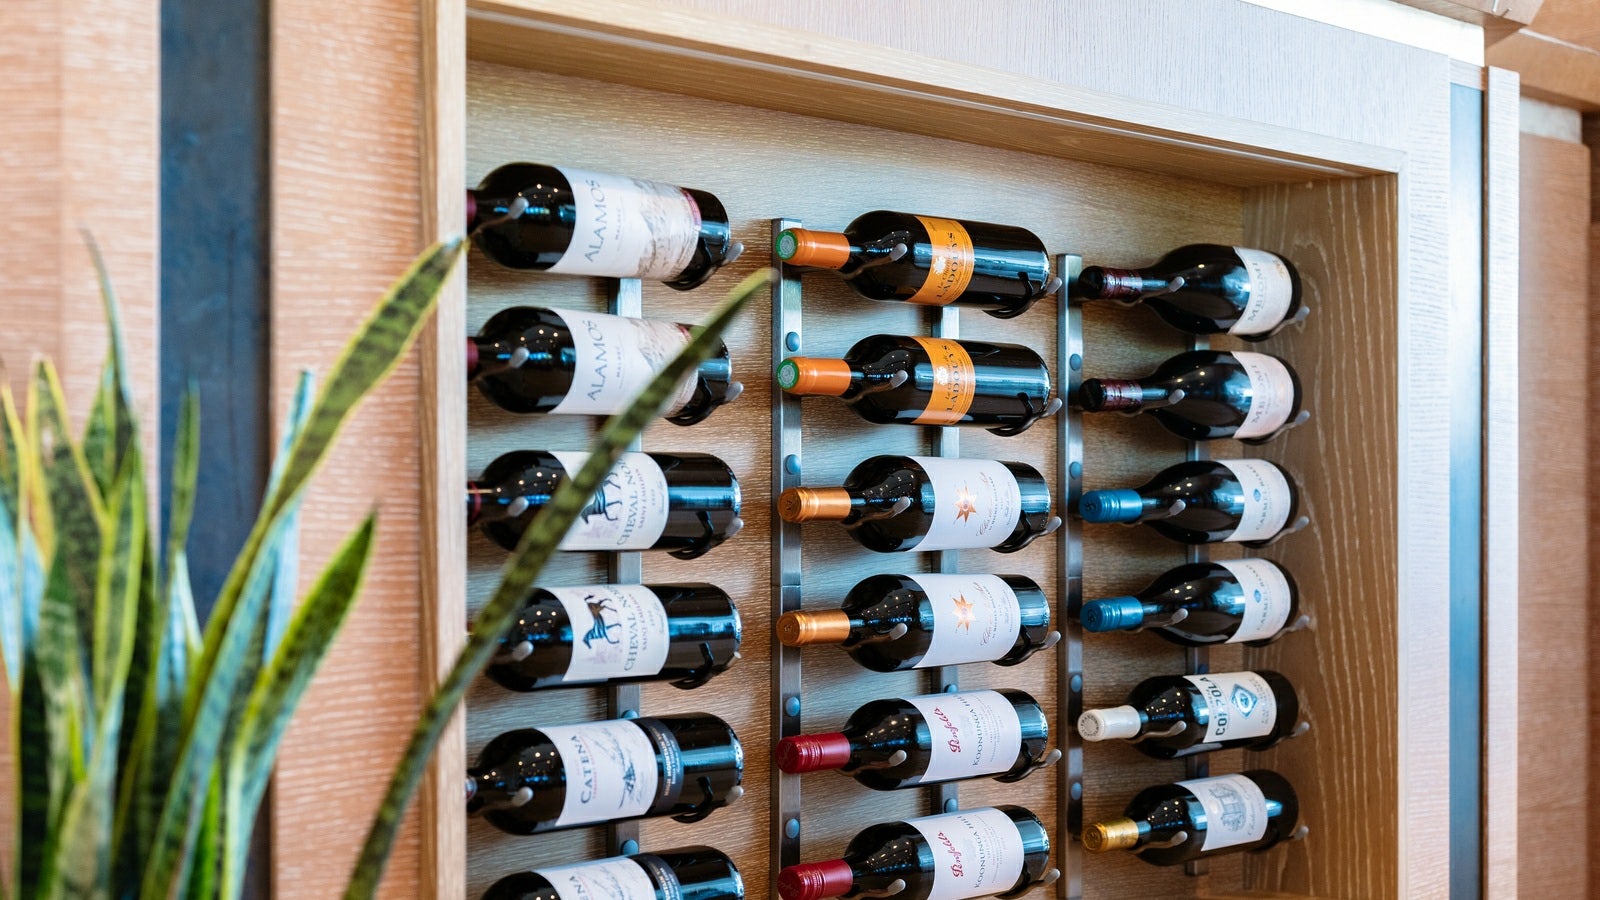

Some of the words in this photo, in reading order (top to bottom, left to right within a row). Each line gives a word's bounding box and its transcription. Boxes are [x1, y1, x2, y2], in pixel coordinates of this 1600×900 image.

[584, 178, 607, 262] ALAMOS
[582, 320, 607, 401] ALAMOS
[616, 490, 638, 545] CHEVAL
[623, 613, 638, 671] CHEVAL
[934, 707, 961, 753] Penfolds
[970, 708, 983, 766] KOONUNGA
[570, 734, 593, 804] CATENA
[937, 831, 964, 878] Penfolds
[973, 831, 985, 888] KOONUNGA
[569, 875, 588, 900] ENA
